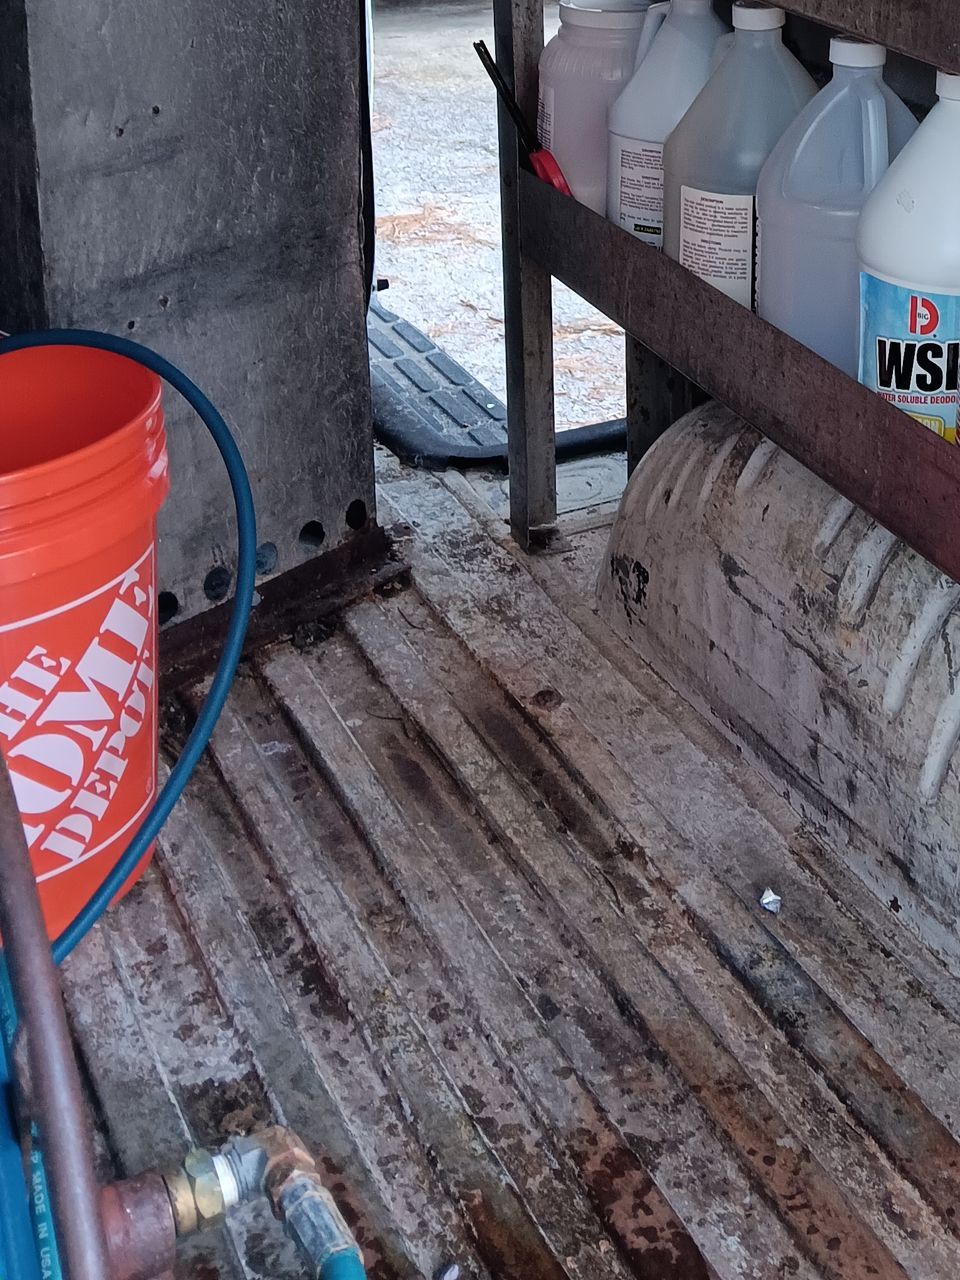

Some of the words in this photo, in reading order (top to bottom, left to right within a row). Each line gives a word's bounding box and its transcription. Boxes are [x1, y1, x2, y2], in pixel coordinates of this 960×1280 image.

[917, 312, 929, 320] BIG
[898, 395, 928, 404] SOLUBLE
[8, 569, 153, 830] OME
[32, 1171, 46, 1215] MADE
[38, 1223, 48, 1240] IN
[41, 1248, 52, 1279] USA
